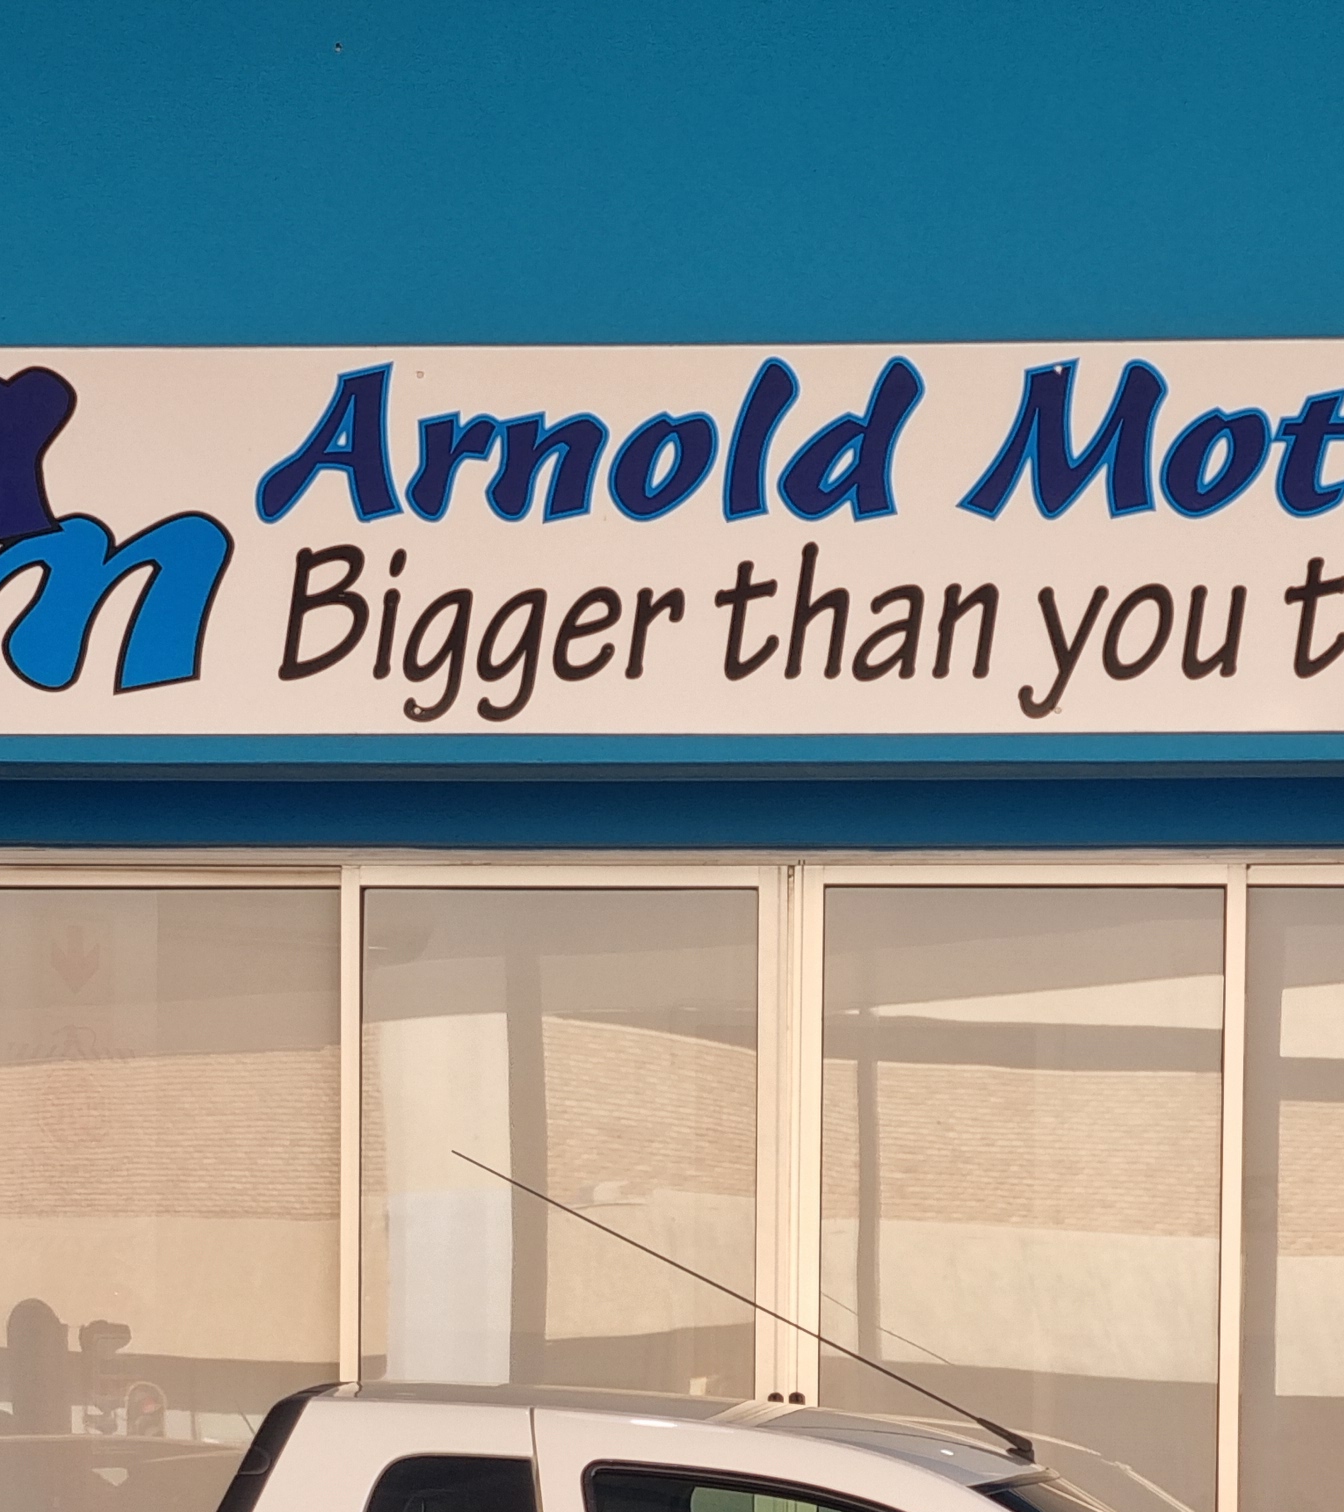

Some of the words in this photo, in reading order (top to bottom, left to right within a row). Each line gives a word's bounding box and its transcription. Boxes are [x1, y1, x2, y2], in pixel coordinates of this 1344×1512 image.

[256, 355, 926, 523] Arnold
[278, 544, 685, 722] Bigger
[714, 542, 999, 682] than
[1018, 583, 1247, 719] you
